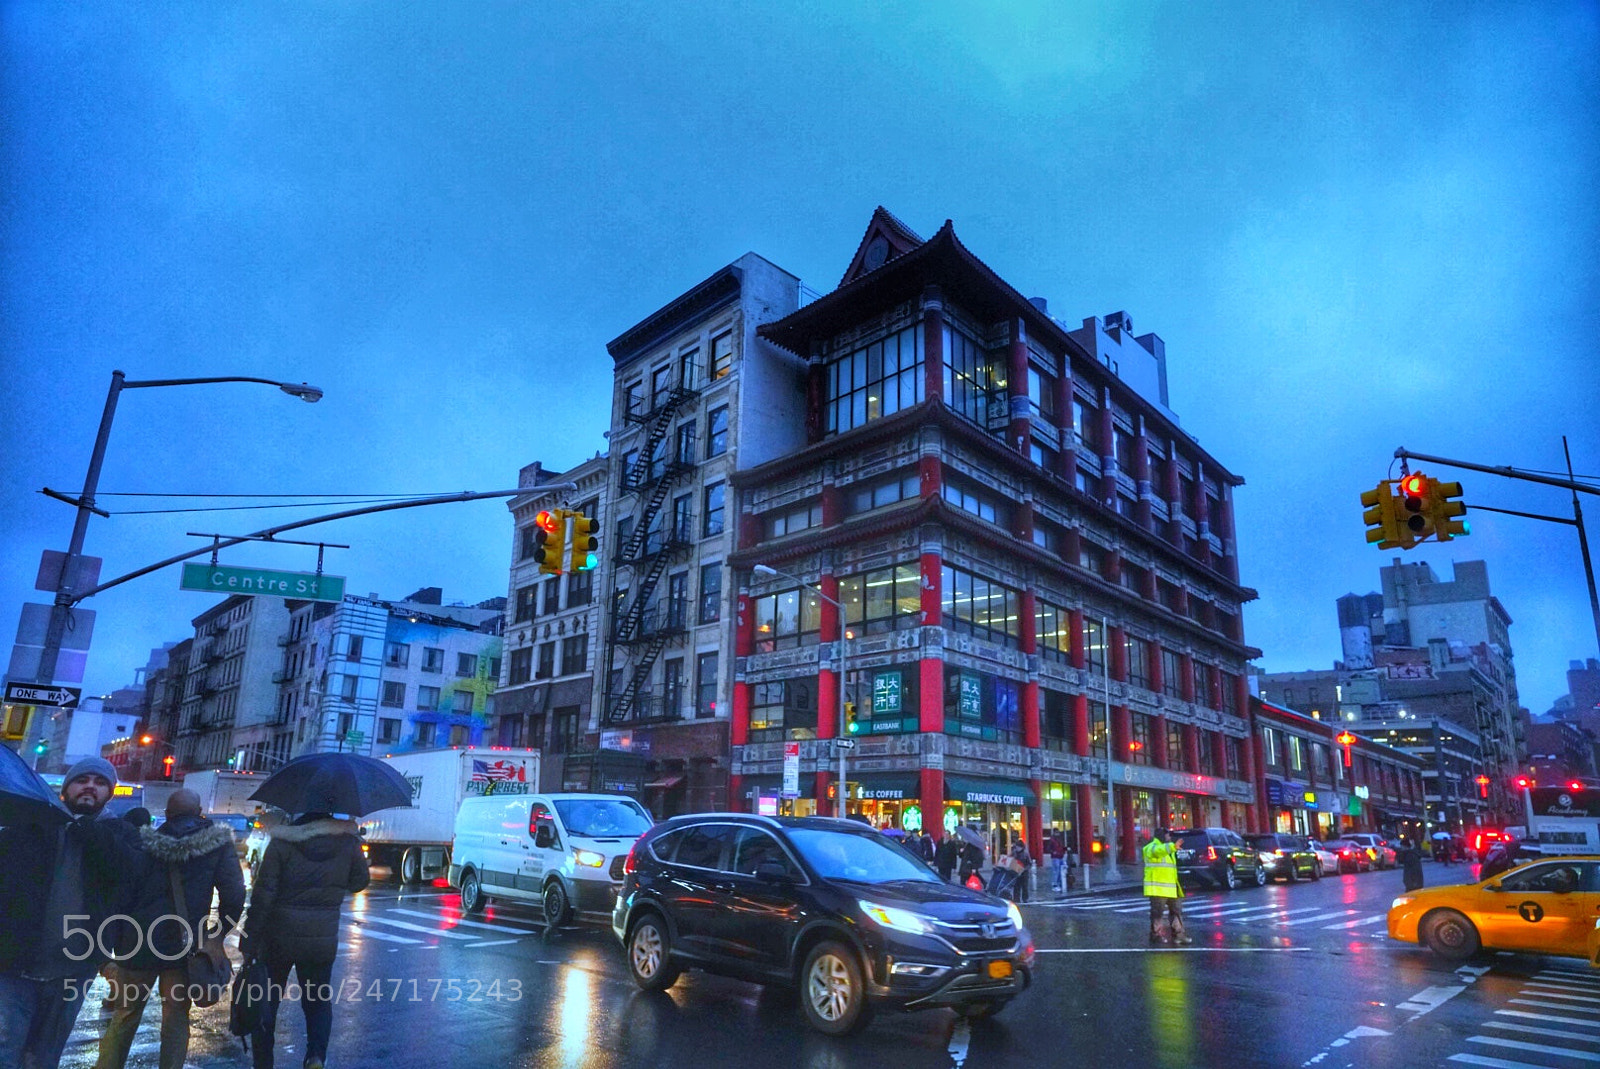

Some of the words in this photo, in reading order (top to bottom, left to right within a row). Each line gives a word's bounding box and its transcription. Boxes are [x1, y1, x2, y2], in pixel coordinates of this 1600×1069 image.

[211, 572, 288, 591] Centre
[295, 579, 319, 593] St
[16, 688, 38, 699] ONE
[47, 691, 70, 702] WAY
[873, 722, 900, 731] EASTBANK
[875, 790, 903, 799] COFFEE
[966, 792, 1002, 804] STARBUCKS
[1002, 795, 1024, 805] COFFEE
